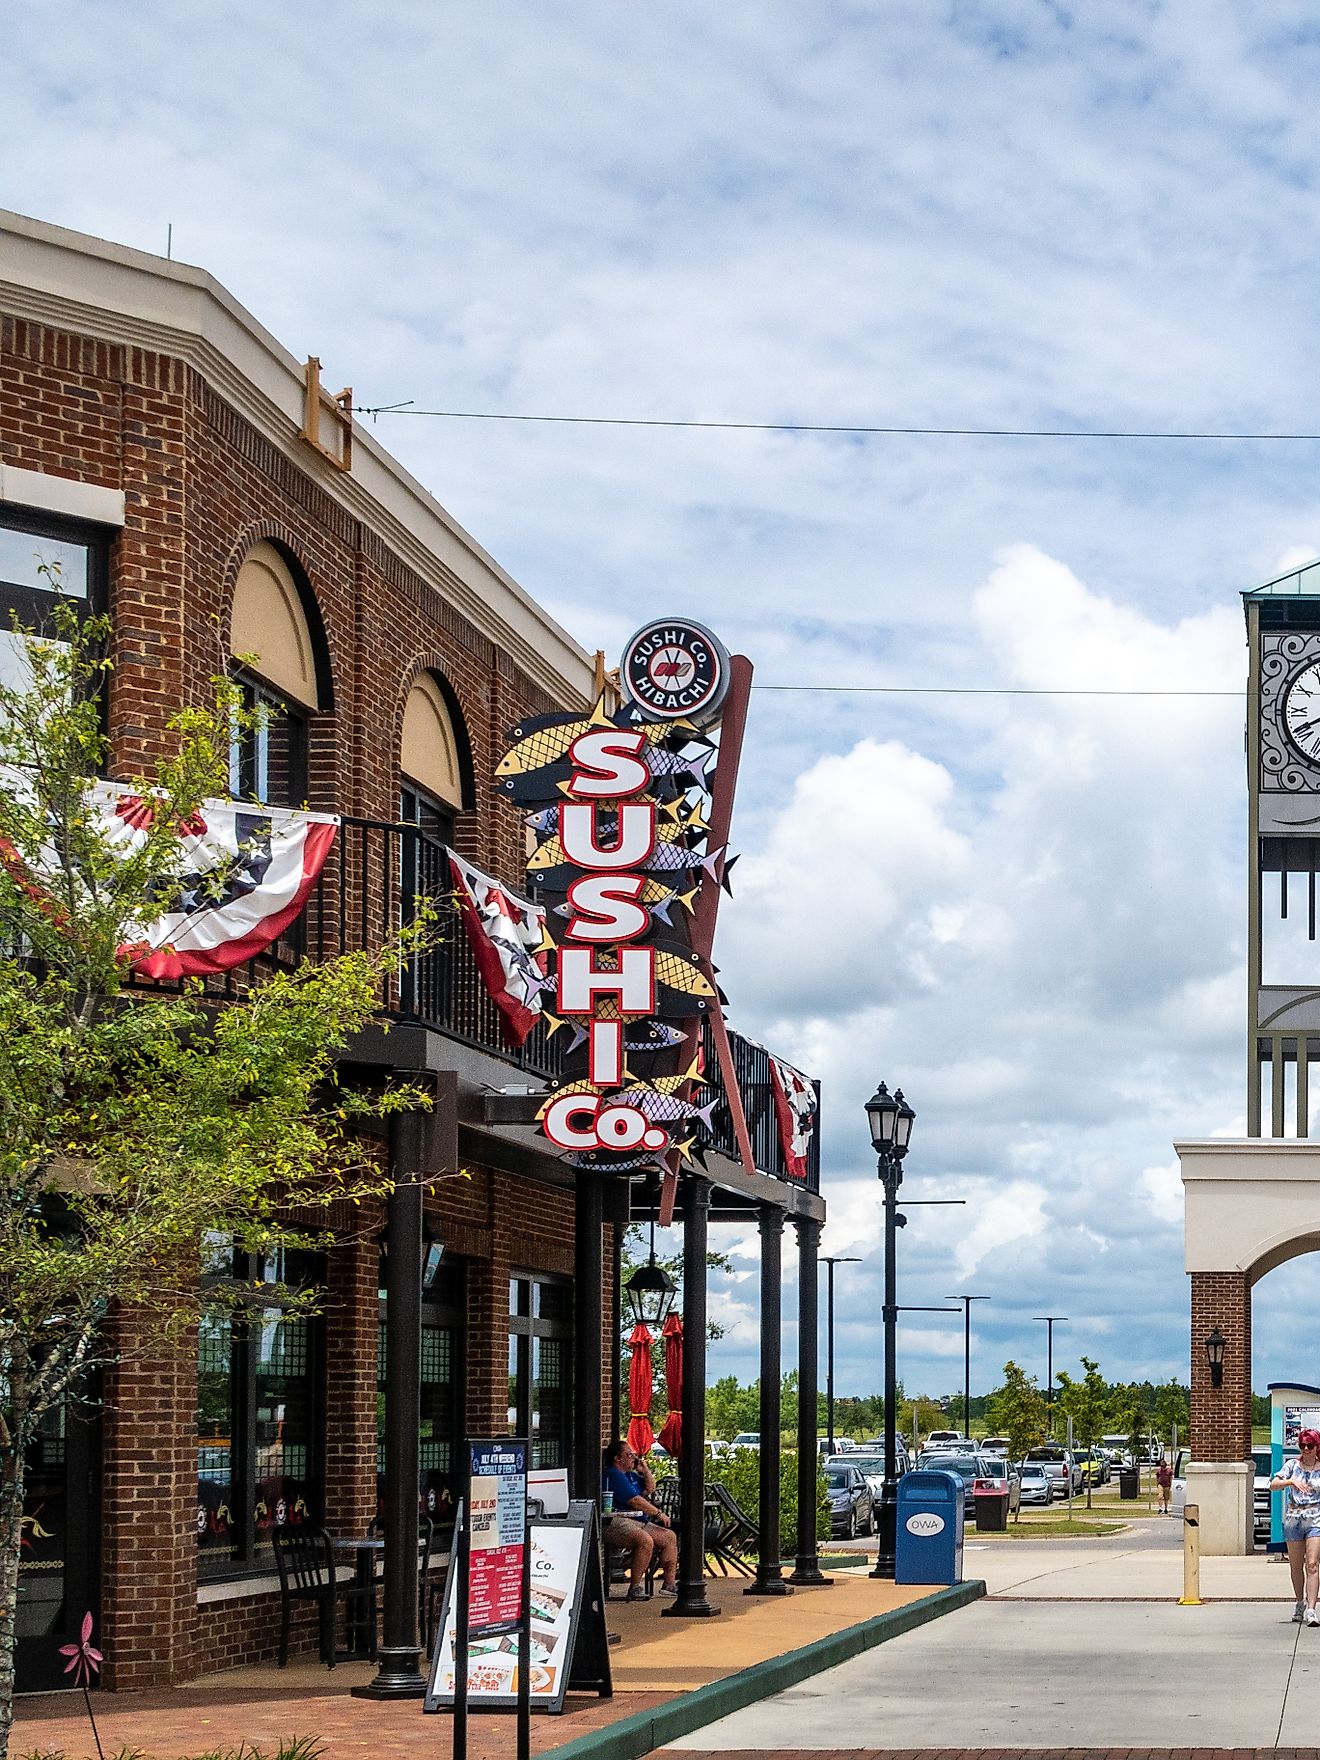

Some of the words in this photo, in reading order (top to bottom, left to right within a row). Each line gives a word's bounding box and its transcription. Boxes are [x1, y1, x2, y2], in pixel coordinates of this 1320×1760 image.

[634, 631, 685, 666] SUSHI
[690, 641, 707, 668] Co.
[636, 676, 709, 708] HIBACHI
[1296, 684, 1314, 698] X
[557, 729, 655, 1087] SUSHI
[543, 1093, 669, 1151] Co.
[911, 1520, 938, 1529] OWA
[535, 1560, 555, 1570] Co.
